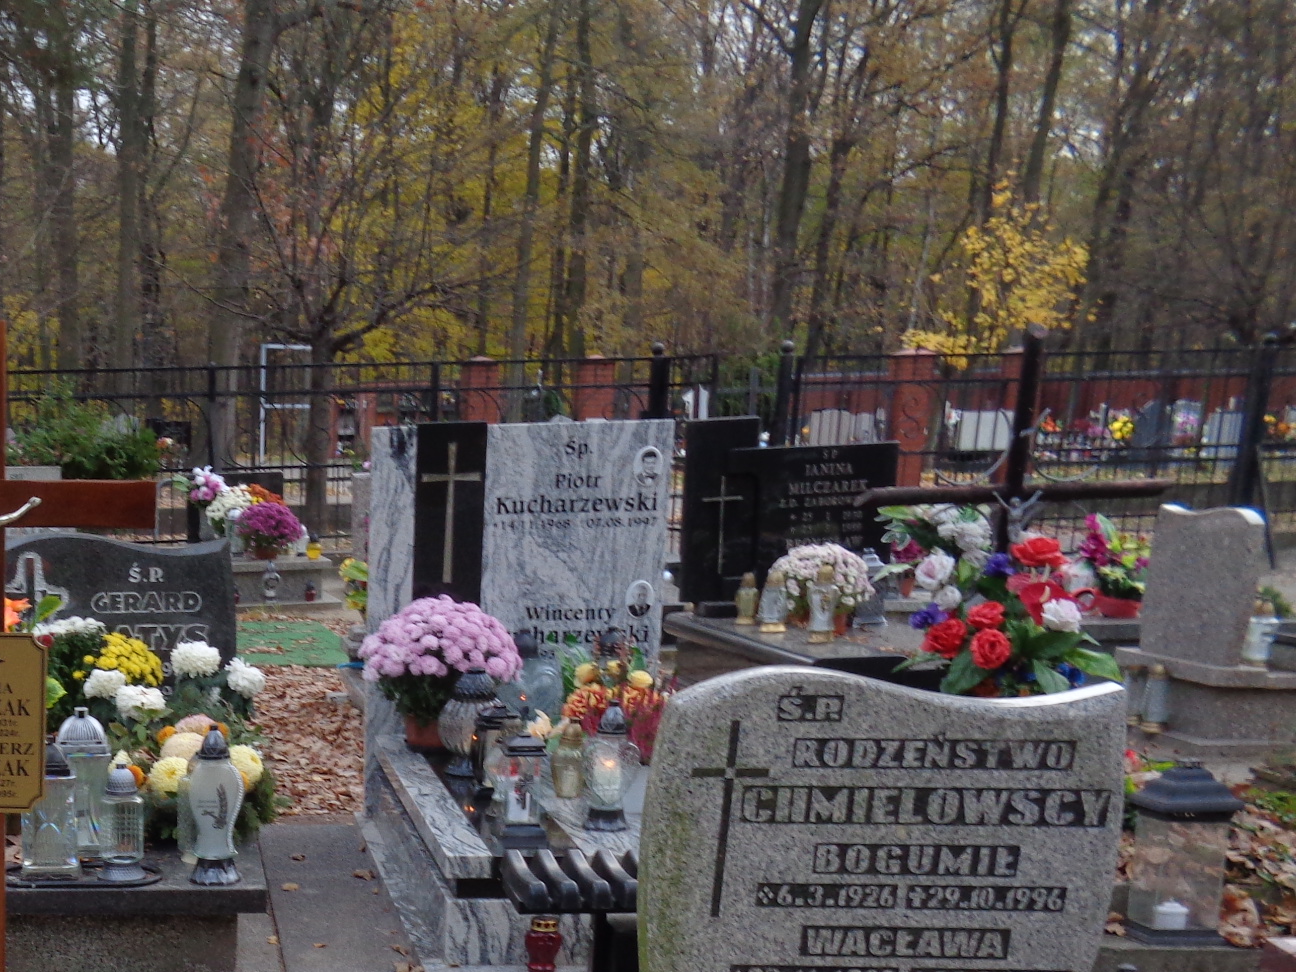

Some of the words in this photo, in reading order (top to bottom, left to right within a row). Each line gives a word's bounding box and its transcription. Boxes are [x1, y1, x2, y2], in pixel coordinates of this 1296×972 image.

[555, 473, 603, 489] Piotr
[788, 479, 869, 495] MILCZAREK
[496, 492, 657, 515] Kucharzewski
[91, 591, 203, 614] GERARD
[526, 604, 617, 624] Wincenty
[780, 687, 841, 720] Ś.P.
[796, 733, 1075, 770] RODZEŃSTWO
[742, 786, 1112, 828] CHMIELOWSCY
[816, 844, 1020, 876] BOGUMIŁ
[806, 928, 1004, 957] WACŁAWA
